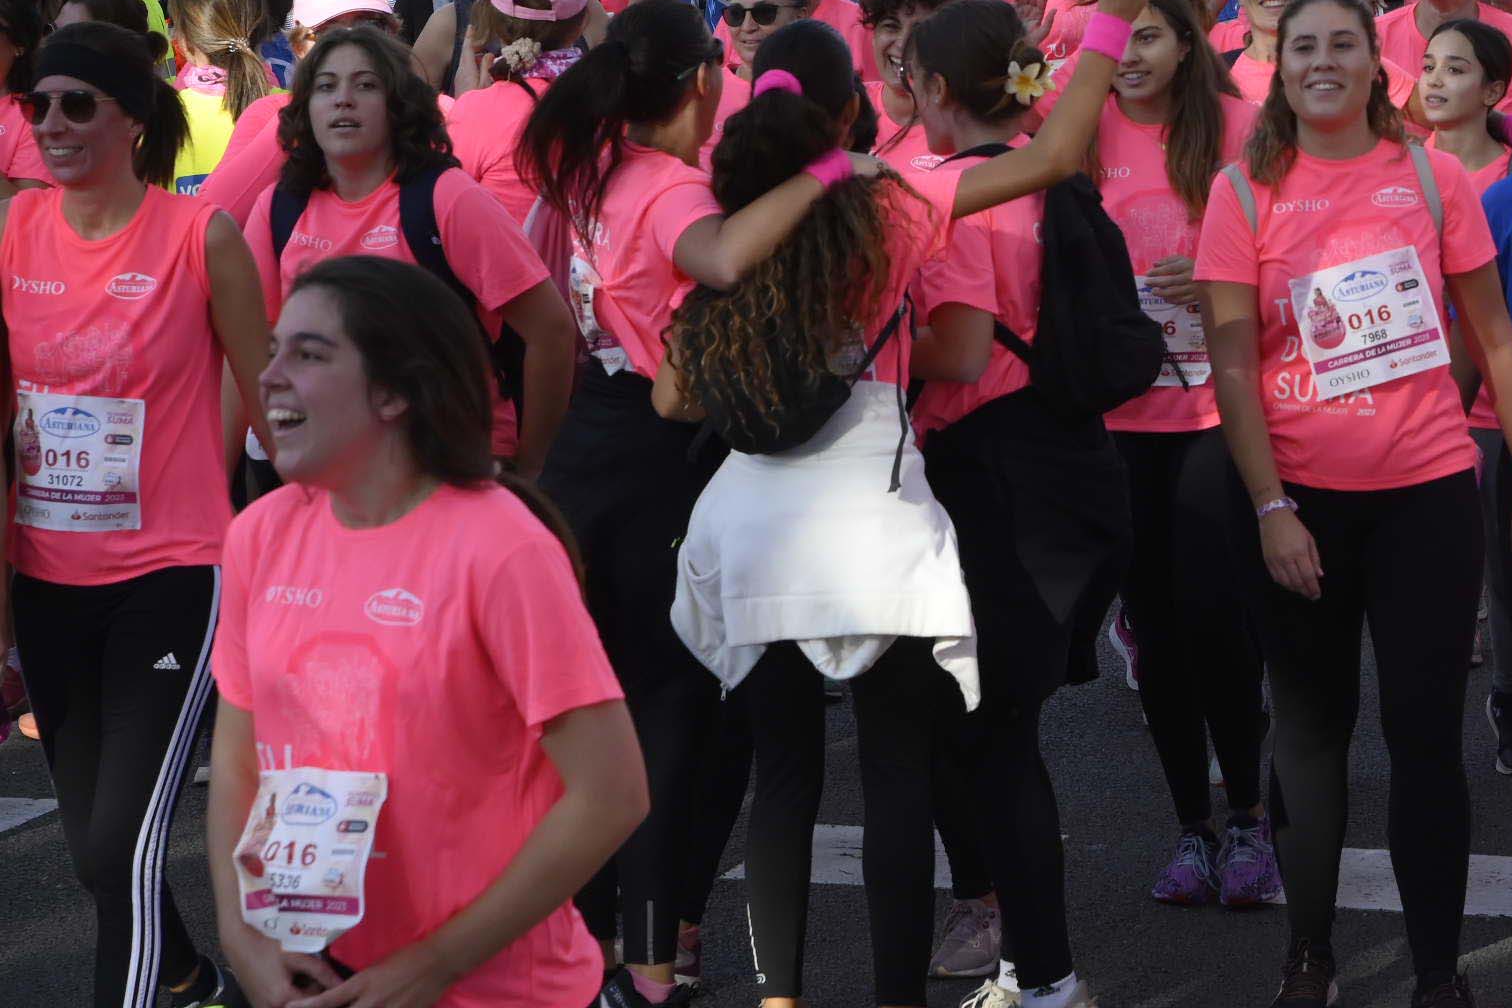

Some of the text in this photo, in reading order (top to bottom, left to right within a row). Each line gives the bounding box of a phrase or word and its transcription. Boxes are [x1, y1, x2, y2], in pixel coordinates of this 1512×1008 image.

[1273, 199, 1330, 214] OYSHO
[1338, 279, 1385, 297] ASTURIANA
[1274, 298, 1289, 326] T
[1347, 304, 1392, 330] 016
[1361, 329, 1388, 345] 7968
[1328, 351, 1364, 369] CARRERA
[1365, 347, 1377, 357] DE
[1377, 345, 1386, 354] LA
[1386, 338, 1412, 351] MUJER
[1399, 349, 1437, 367] Santander
[1329, 368, 1370, 388] OYSHO
[45, 449, 90, 469] 016
[48, 474, 84, 487] 31072
[83, 511, 130, 521] Santander
[154, 661, 181, 670] adidas
[264, 842, 317, 866] 016
